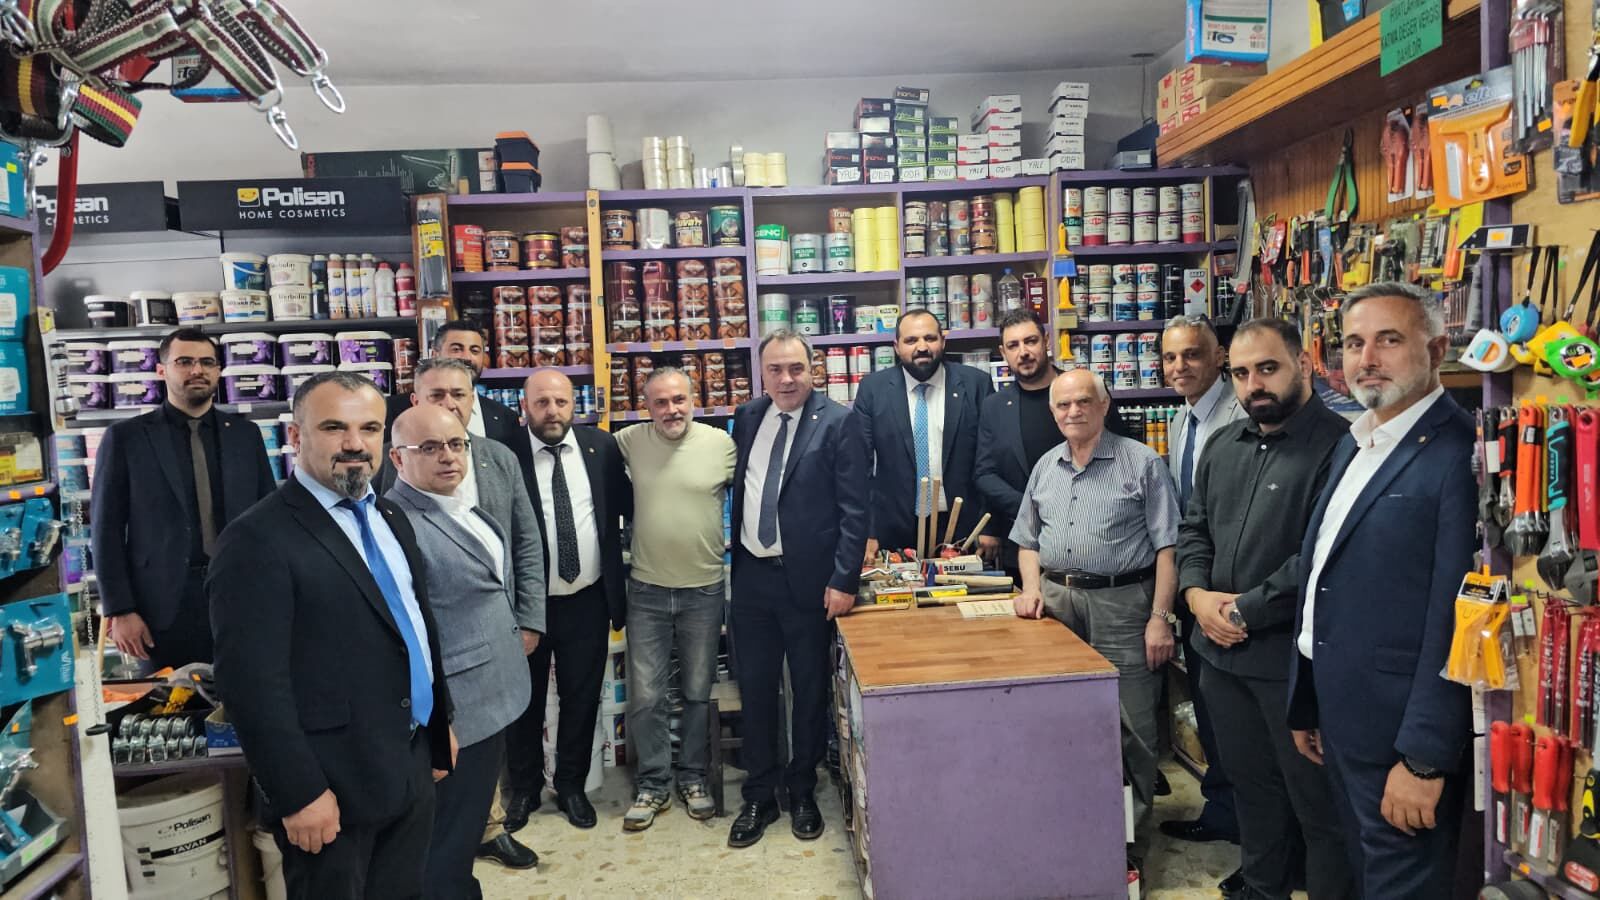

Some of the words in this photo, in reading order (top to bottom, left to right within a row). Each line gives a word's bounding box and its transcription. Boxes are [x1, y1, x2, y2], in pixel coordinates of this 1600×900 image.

[36, 194, 109, 213] Posan
[262, 187, 345, 207] Polisan
[240, 210, 273, 219] HOME
[279, 208, 346, 218] COSMETICS
[174, 813, 212, 832] Polisan
[171, 838, 208, 856] TAVAN
